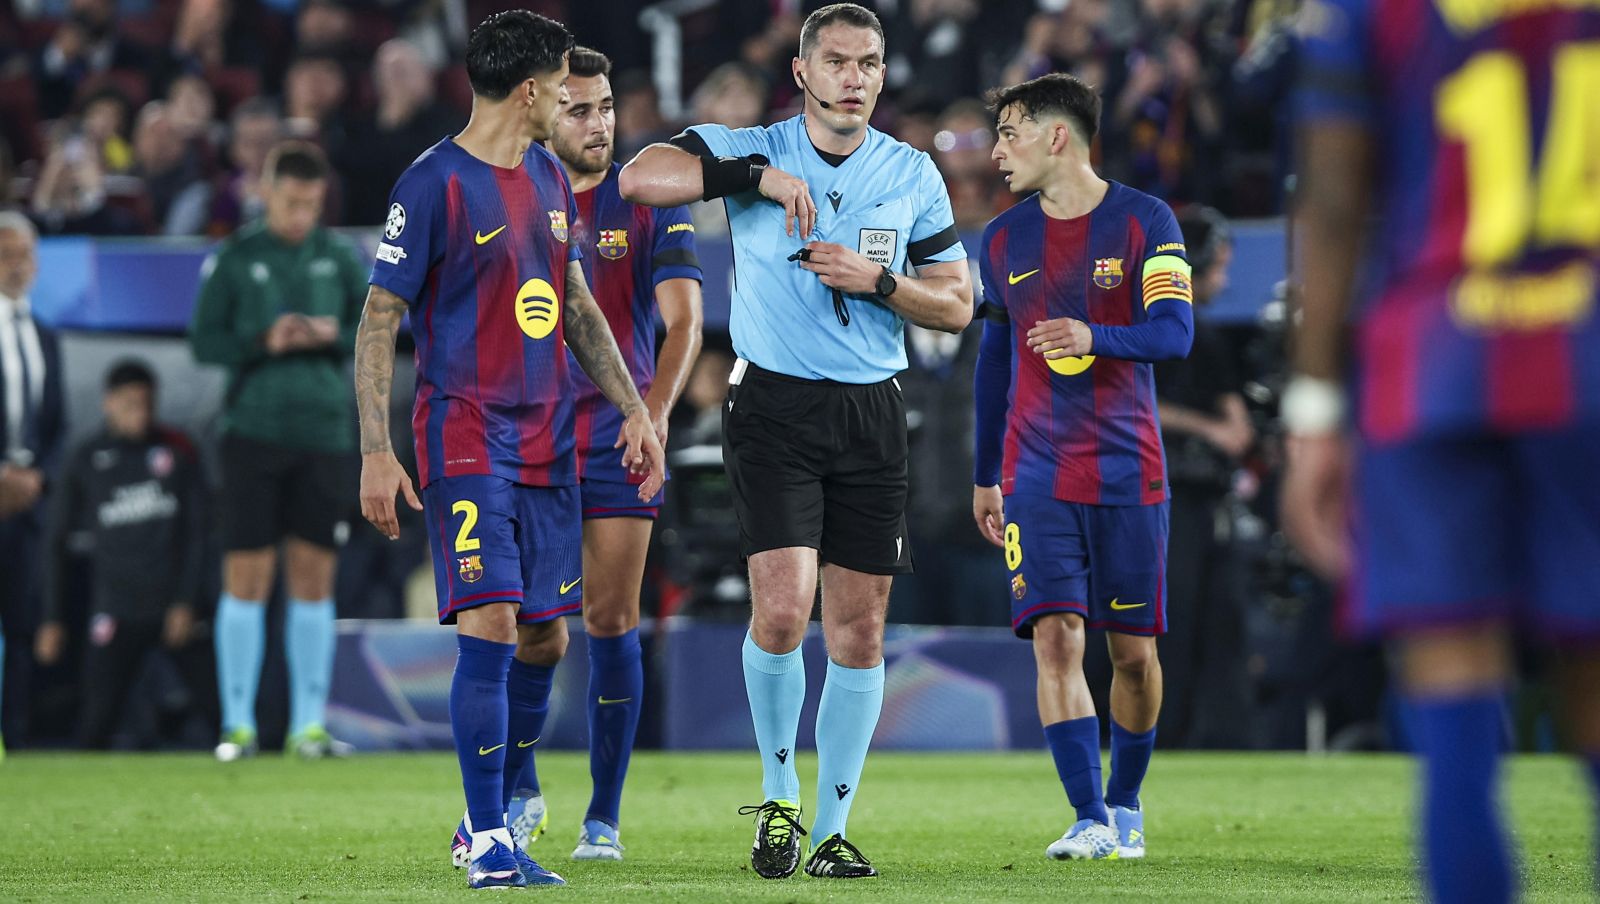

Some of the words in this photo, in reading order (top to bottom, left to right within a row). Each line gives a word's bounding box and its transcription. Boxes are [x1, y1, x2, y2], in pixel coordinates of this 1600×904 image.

[1435, 46, 1600, 265] 14
[865, 256, 890, 264] FICIAL
[867, 234, 889, 244] UEFA
[452, 499, 480, 552] 2
[1004, 522, 1023, 571] 8
